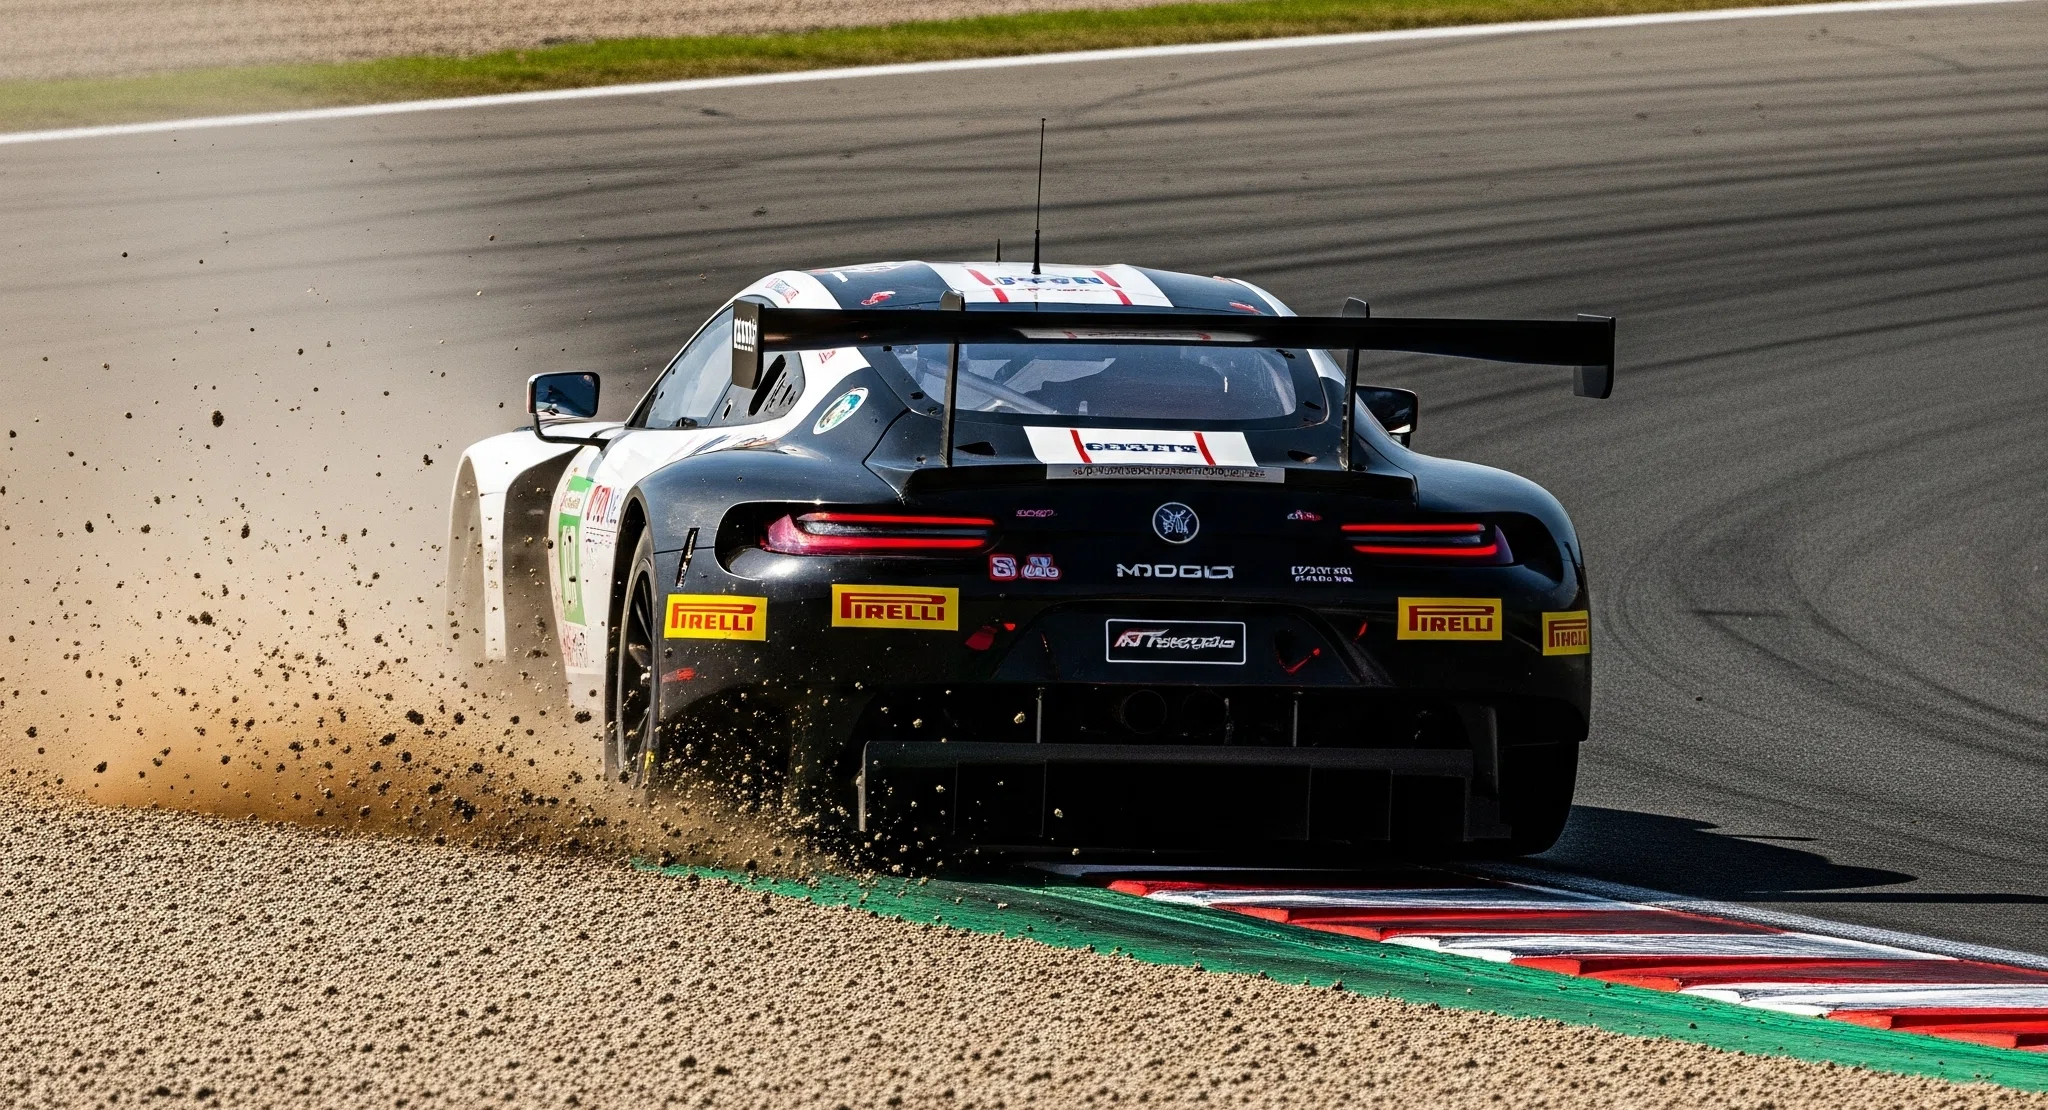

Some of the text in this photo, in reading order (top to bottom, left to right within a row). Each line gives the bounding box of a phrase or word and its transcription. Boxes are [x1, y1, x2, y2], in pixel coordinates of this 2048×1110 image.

[671, 603, 757, 632] PIRELLI
[840, 592, 948, 621] PIRELLI
[1408, 605, 1495, 632] PIRELLI
